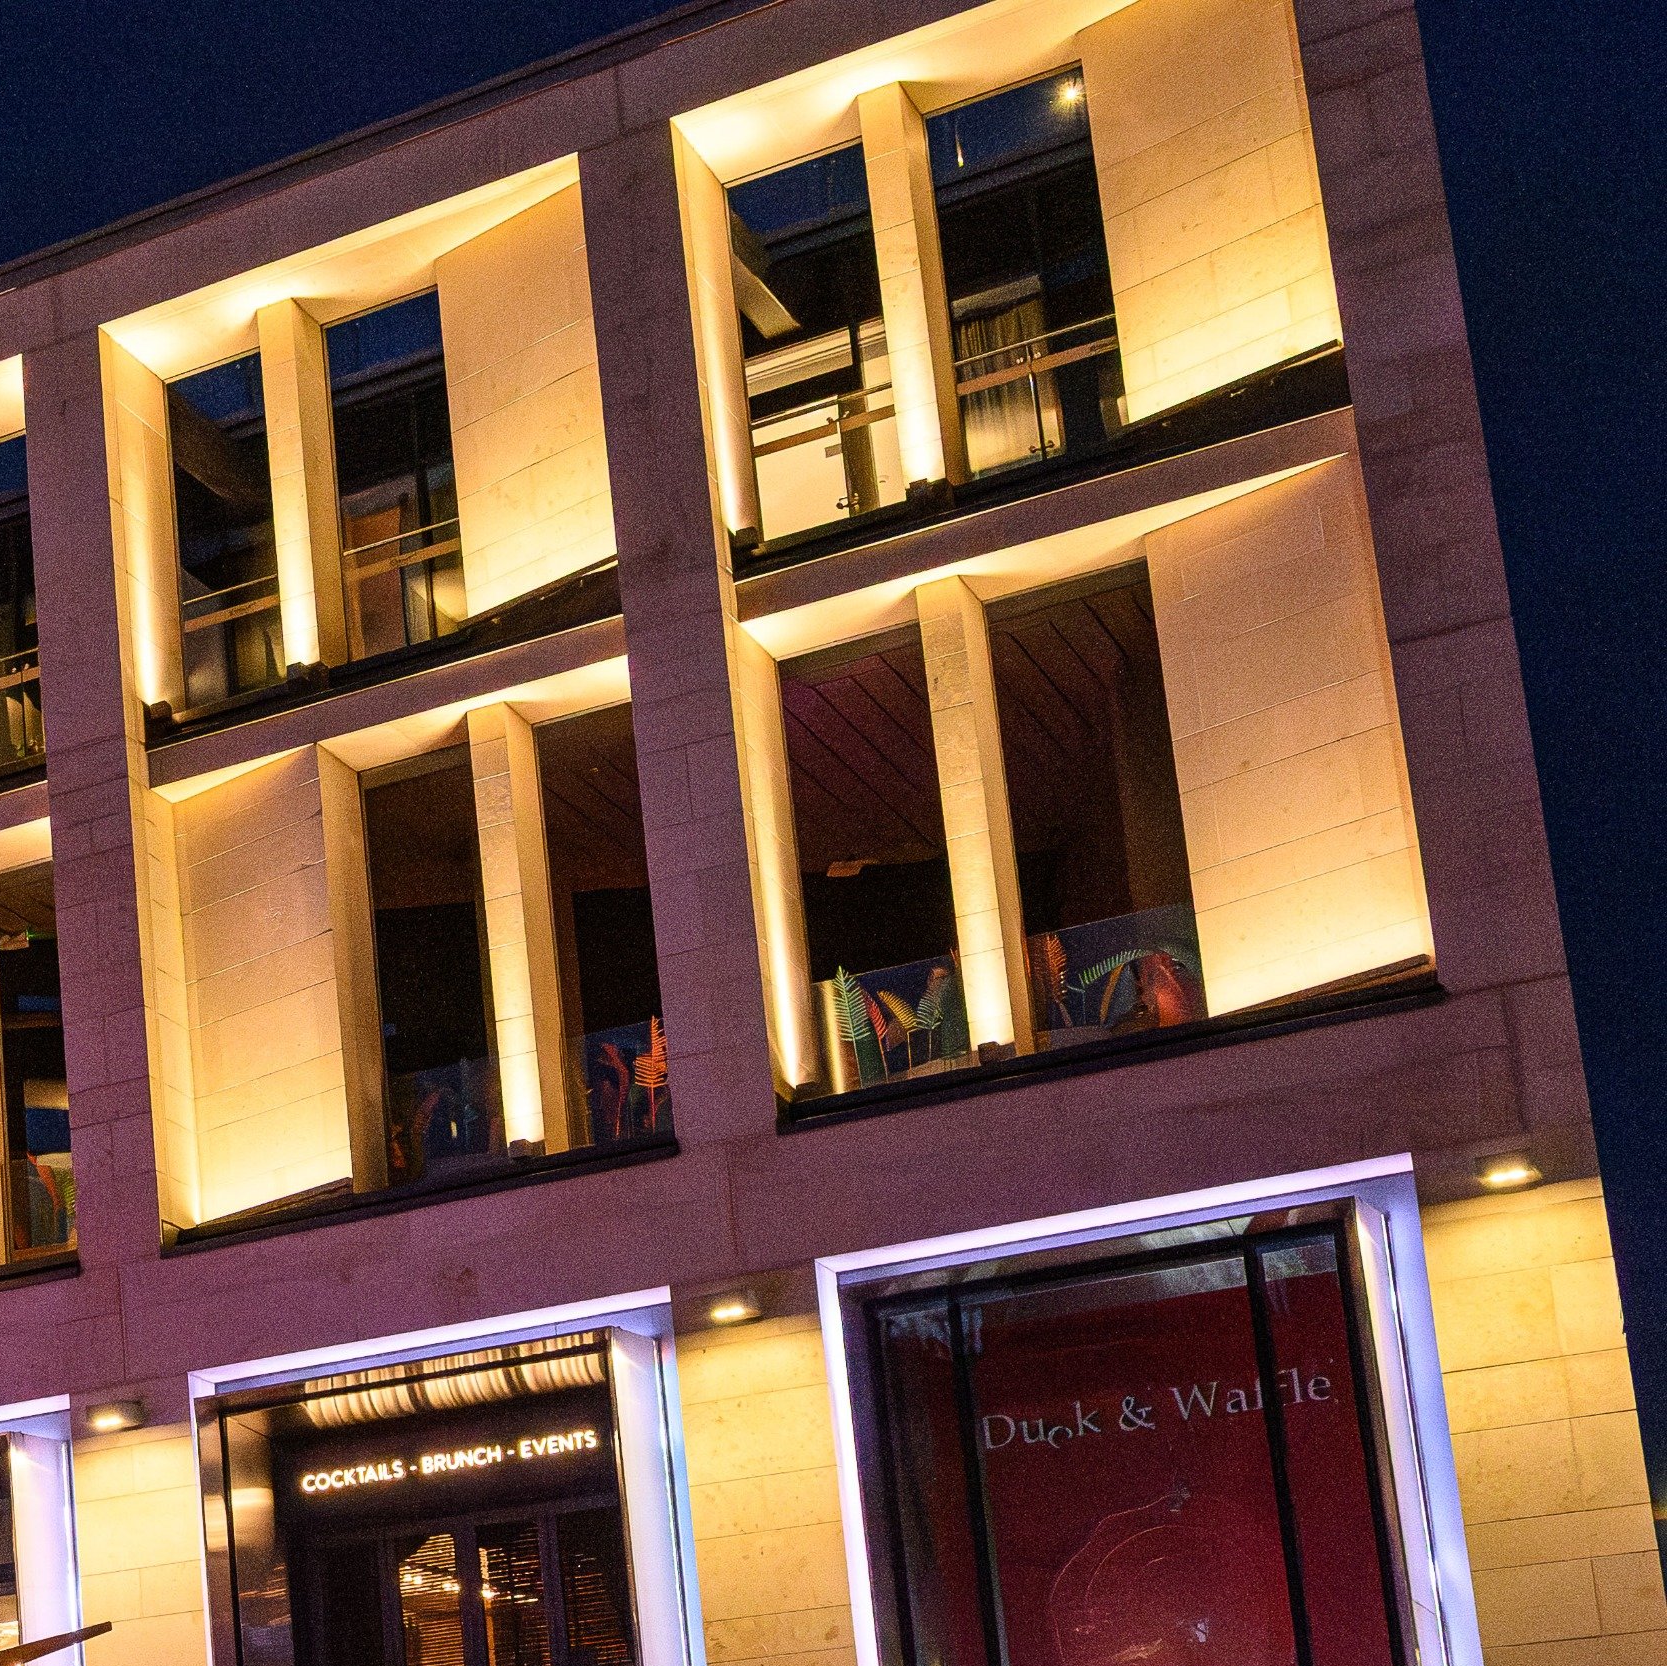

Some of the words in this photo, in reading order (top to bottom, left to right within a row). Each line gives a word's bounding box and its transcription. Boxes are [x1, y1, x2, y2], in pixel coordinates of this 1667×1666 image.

[1169, 1367, 1331, 1421] Wafle
[302, 1461, 404, 1493] COCKTAILS
[421, 1445, 502, 1474] BRUNCH
[519, 1430, 597, 1459] EVENTS
